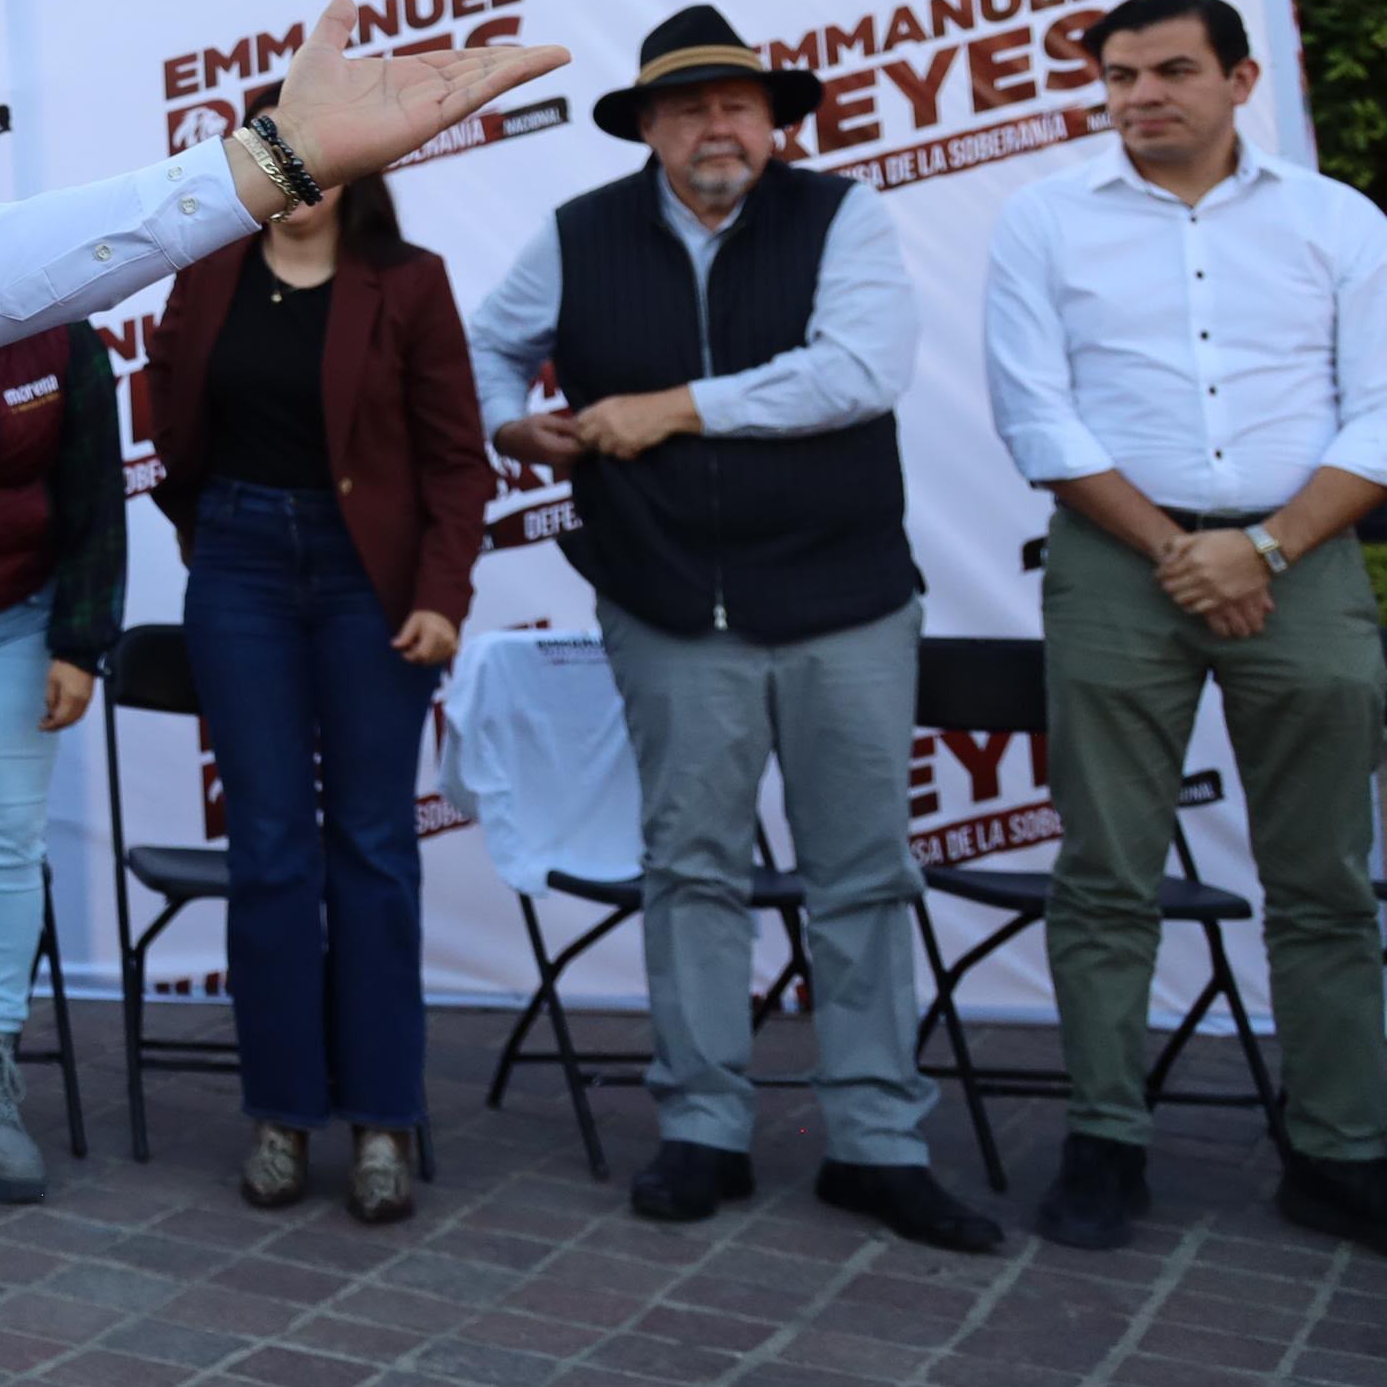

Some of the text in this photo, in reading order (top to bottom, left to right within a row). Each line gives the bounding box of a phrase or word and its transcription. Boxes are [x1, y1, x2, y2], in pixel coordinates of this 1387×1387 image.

[886, 153, 916, 185] DE
[917, 146, 947, 175] LA
[3, 374, 59, 406] morena
[945, 824, 976, 860] DE
[976, 818, 1006, 851] LA
